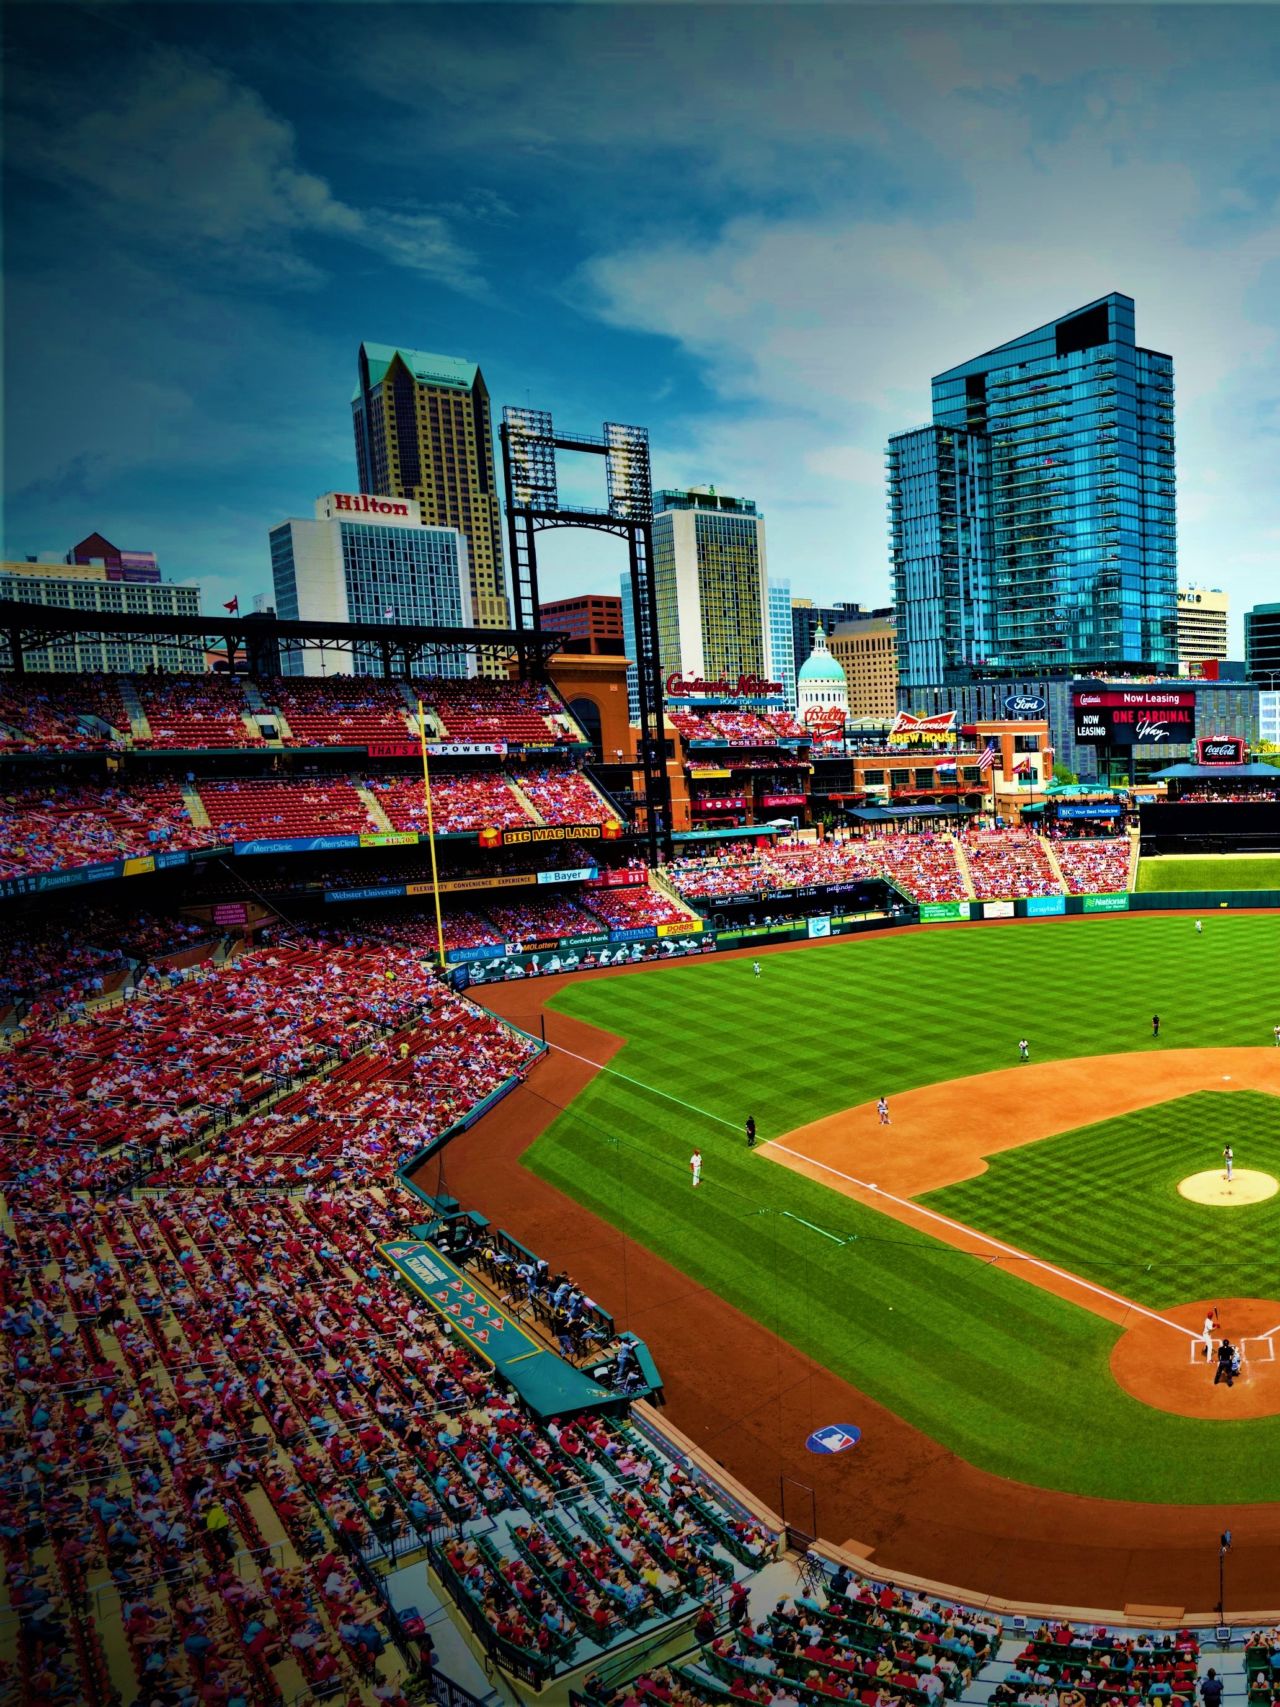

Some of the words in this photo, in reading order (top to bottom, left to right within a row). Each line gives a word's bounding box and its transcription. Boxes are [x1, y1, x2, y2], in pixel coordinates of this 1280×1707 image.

[335, 494, 408, 516] Hilton
[667, 672, 729, 697] Cardinals
[728, 674, 783, 697] Nation
[1014, 697, 1038, 709] Ford
[1123, 693, 1144, 703] Now
[1145, 693, 1180, 705] Leasing
[804, 705, 848, 725] Bally
[1083, 715, 1099, 724] NOW
[1113, 711, 1134, 723] ONE
[1137, 711, 1190, 723] CARDINAL
[1077, 726, 1105, 736] LEASING
[1135, 717, 1170, 741] Way
[889, 734, 919, 743] BREW
[921, 733, 957, 743] HOUSE
[371, 745, 408, 755] THAT'S
[413, 745, 419, 755] A
[1205, 744, 1236, 756] Coca-Cola
[385, 837, 415, 845] $13,705
[504, 831, 531, 844] BIG
[532, 829, 564, 842] MAC
[565, 828, 599, 840] LAND
[554, 870, 581, 881] Bayer
[453, 880, 493, 889] CONVENIENCE
[497, 877, 531, 885] EXPERIENCE
[826, 883, 855, 893] petfinder
[331, 891, 363, 900] Webster
[363, 886, 401, 898] University
[761, 893, 767, 901] P
[1094, 897, 1126, 906] National
[622, 927, 655, 936] SITEMAN
[667, 923, 694, 931] DOBBS
[569, 937, 592, 945] Central
[592, 935, 609, 943] Bank
